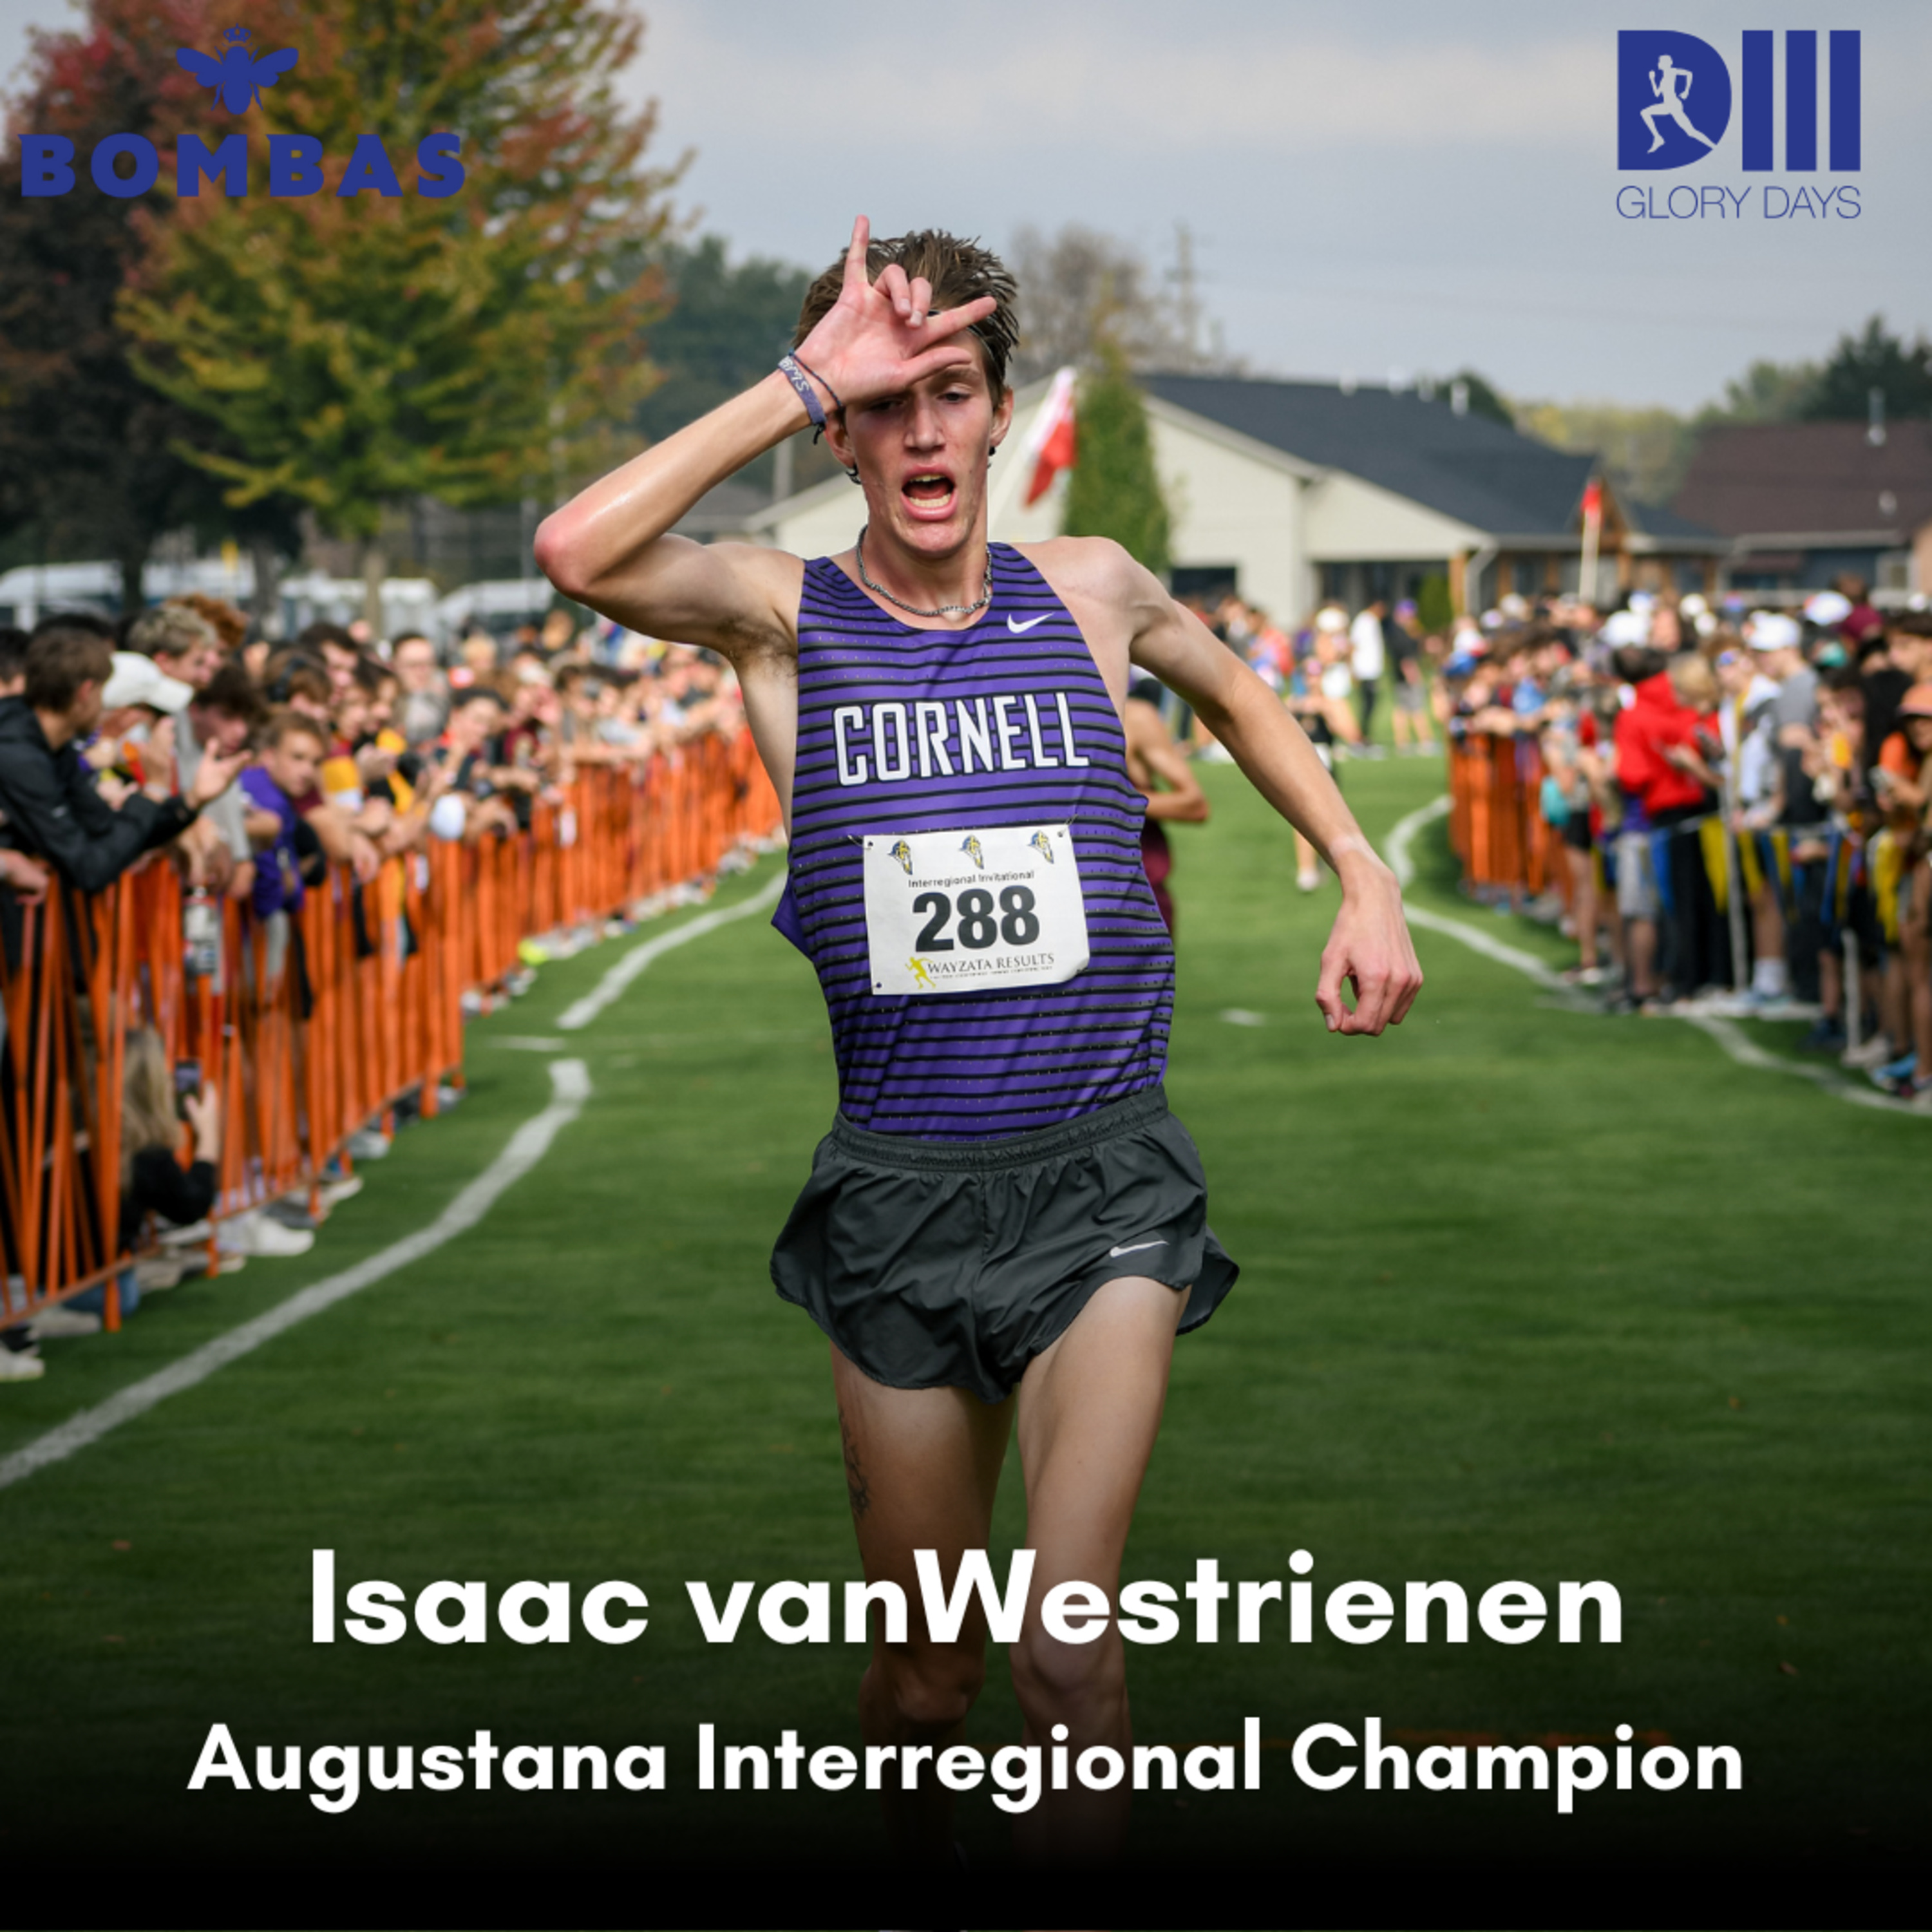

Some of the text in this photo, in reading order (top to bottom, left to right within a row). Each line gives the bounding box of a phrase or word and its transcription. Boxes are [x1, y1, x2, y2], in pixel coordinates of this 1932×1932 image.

[833, 692, 1090, 786] CORNELL
[908, 870, 1035, 888] Interregional Invitational
[912, 885, 1040, 952] 288
[927, 958, 992, 974] WAYZATA
[996, 952, 1055, 969] RESULTS
